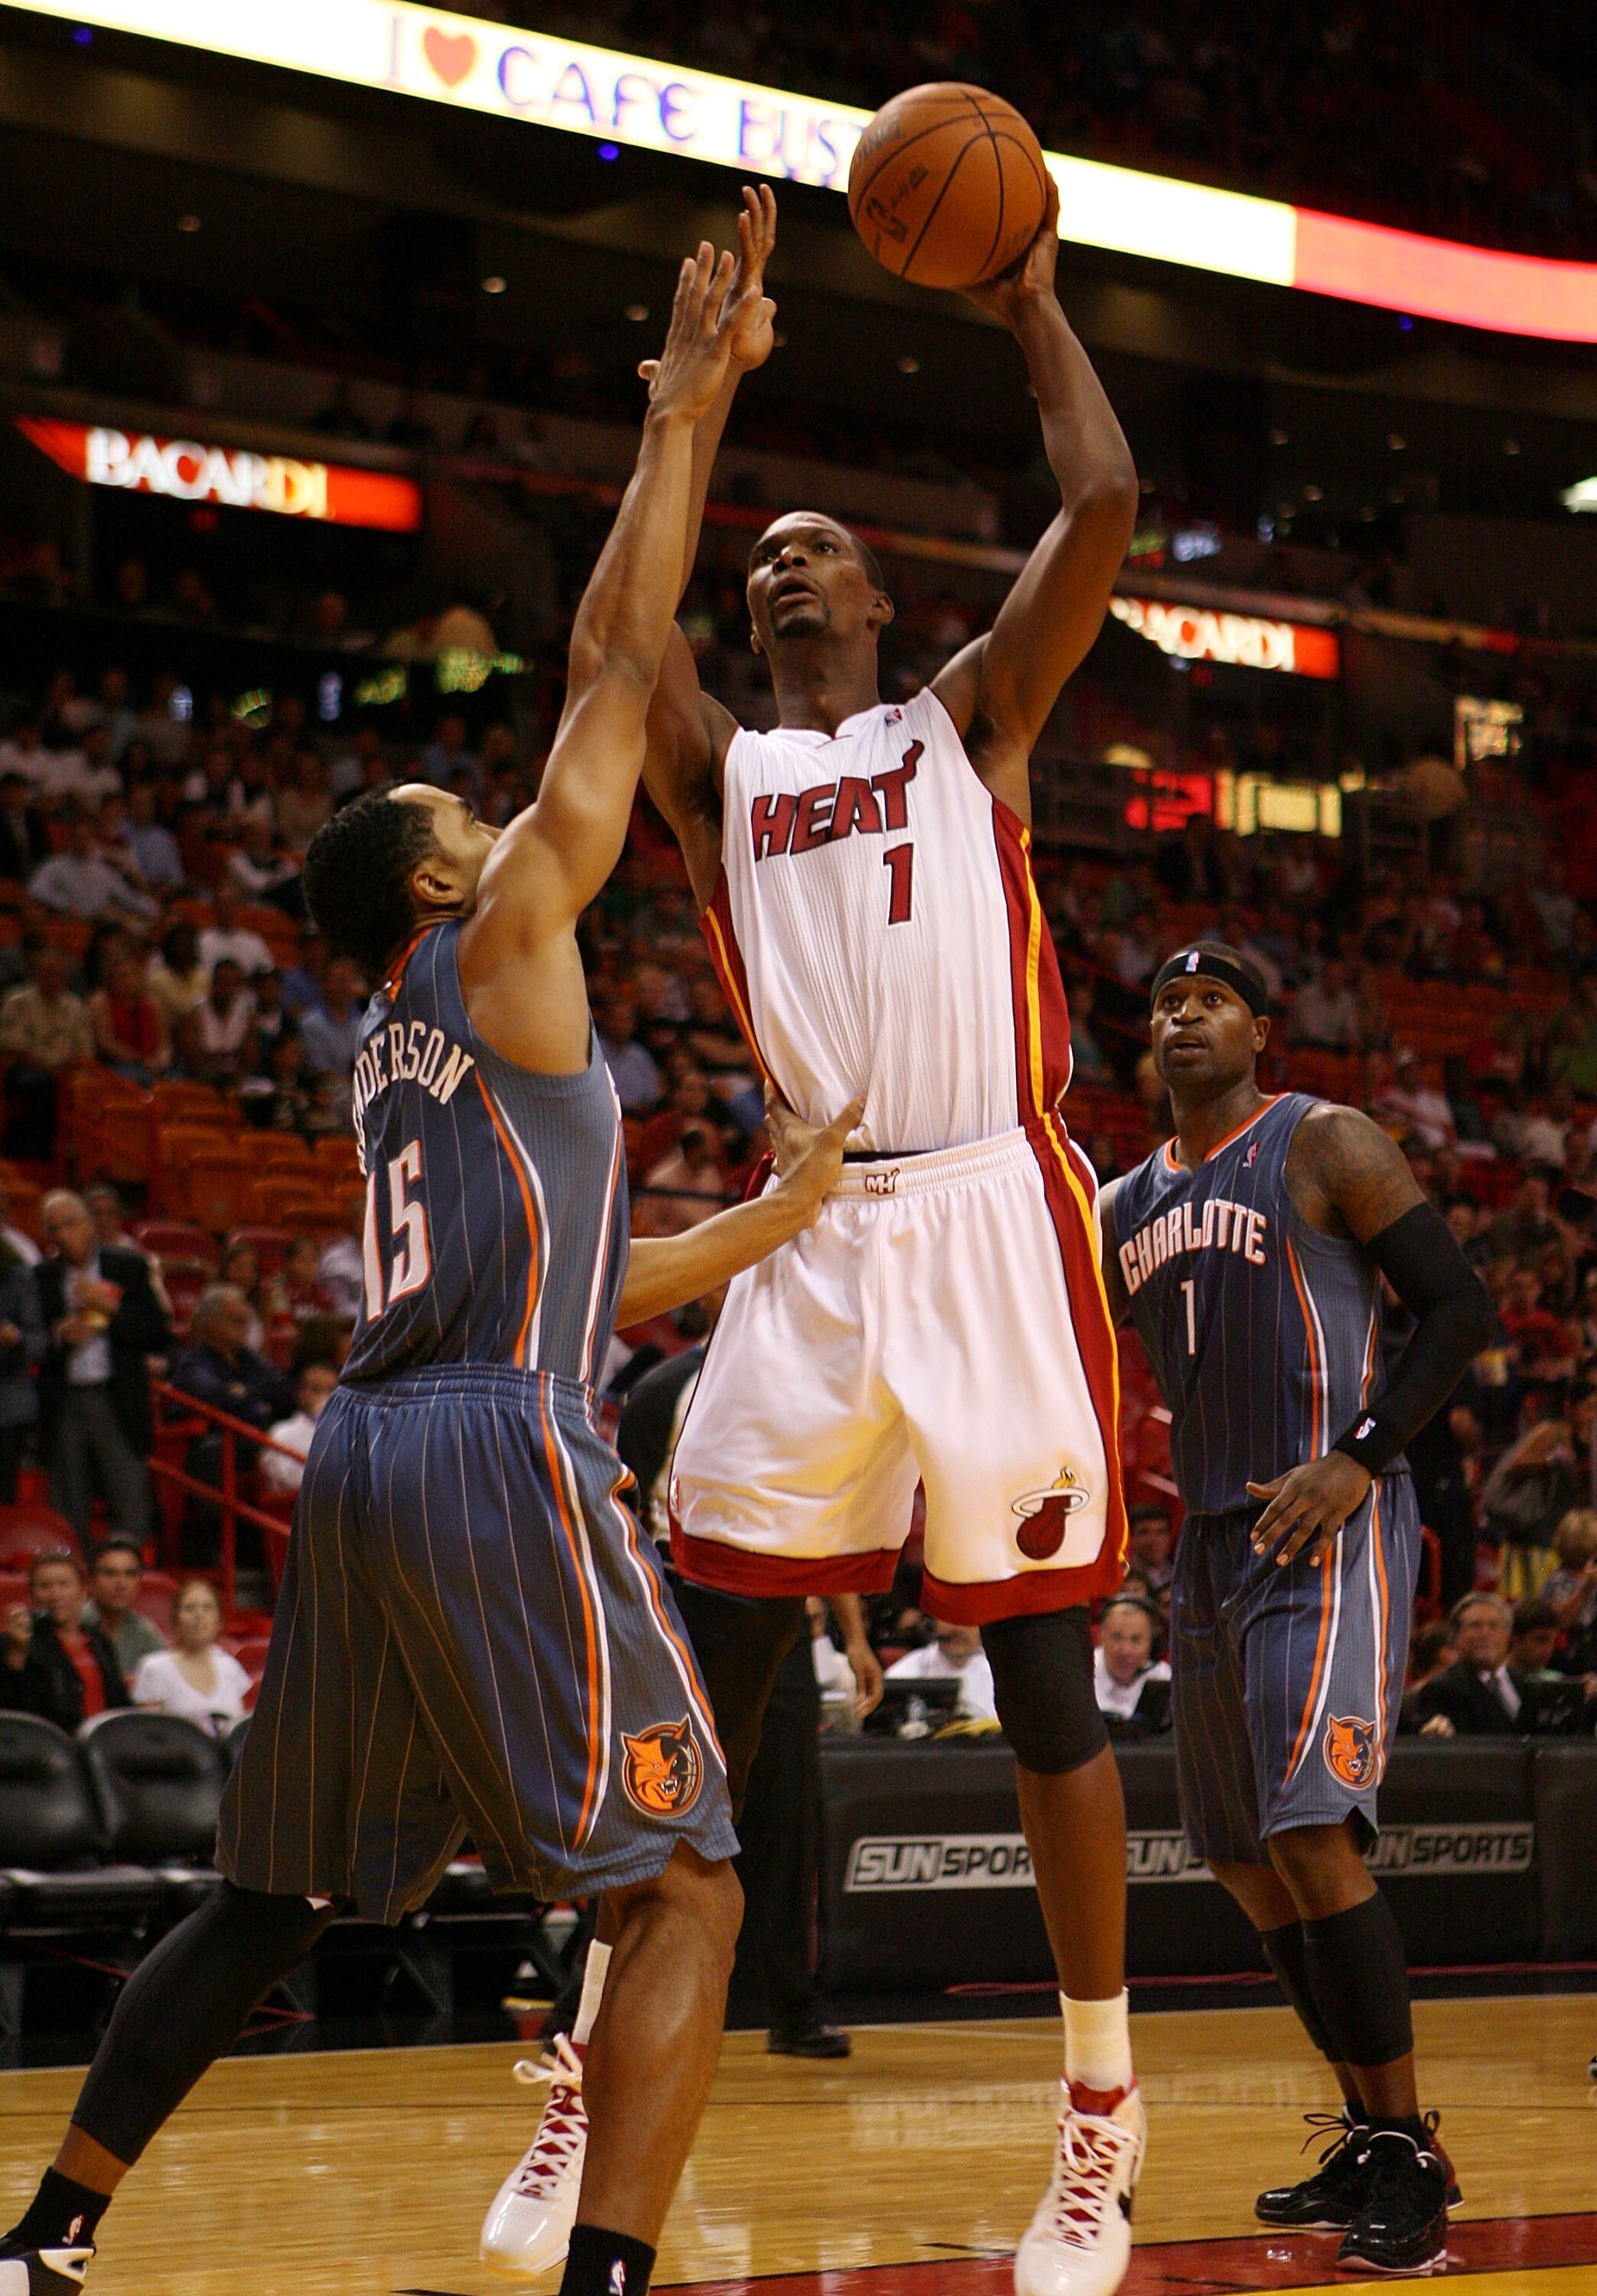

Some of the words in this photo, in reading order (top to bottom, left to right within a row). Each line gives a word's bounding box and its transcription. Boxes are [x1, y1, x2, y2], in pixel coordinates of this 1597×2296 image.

[496, 46, 695, 141] CAFE
[86, 426, 328, 518] BACARDI
[751, 739, 924, 862] HEAT
[883, 843, 914, 925] 1
[363, 1140, 432, 1326] 15
[1119, 1199, 1267, 1296] CHARLOTTE
[1181, 1279, 1195, 1355] 1
[853, 1841, 942, 1885] SUN
[941, 1846, 1032, 1877] SPOR
[1413, 1834, 1529, 1864] SPORTS
